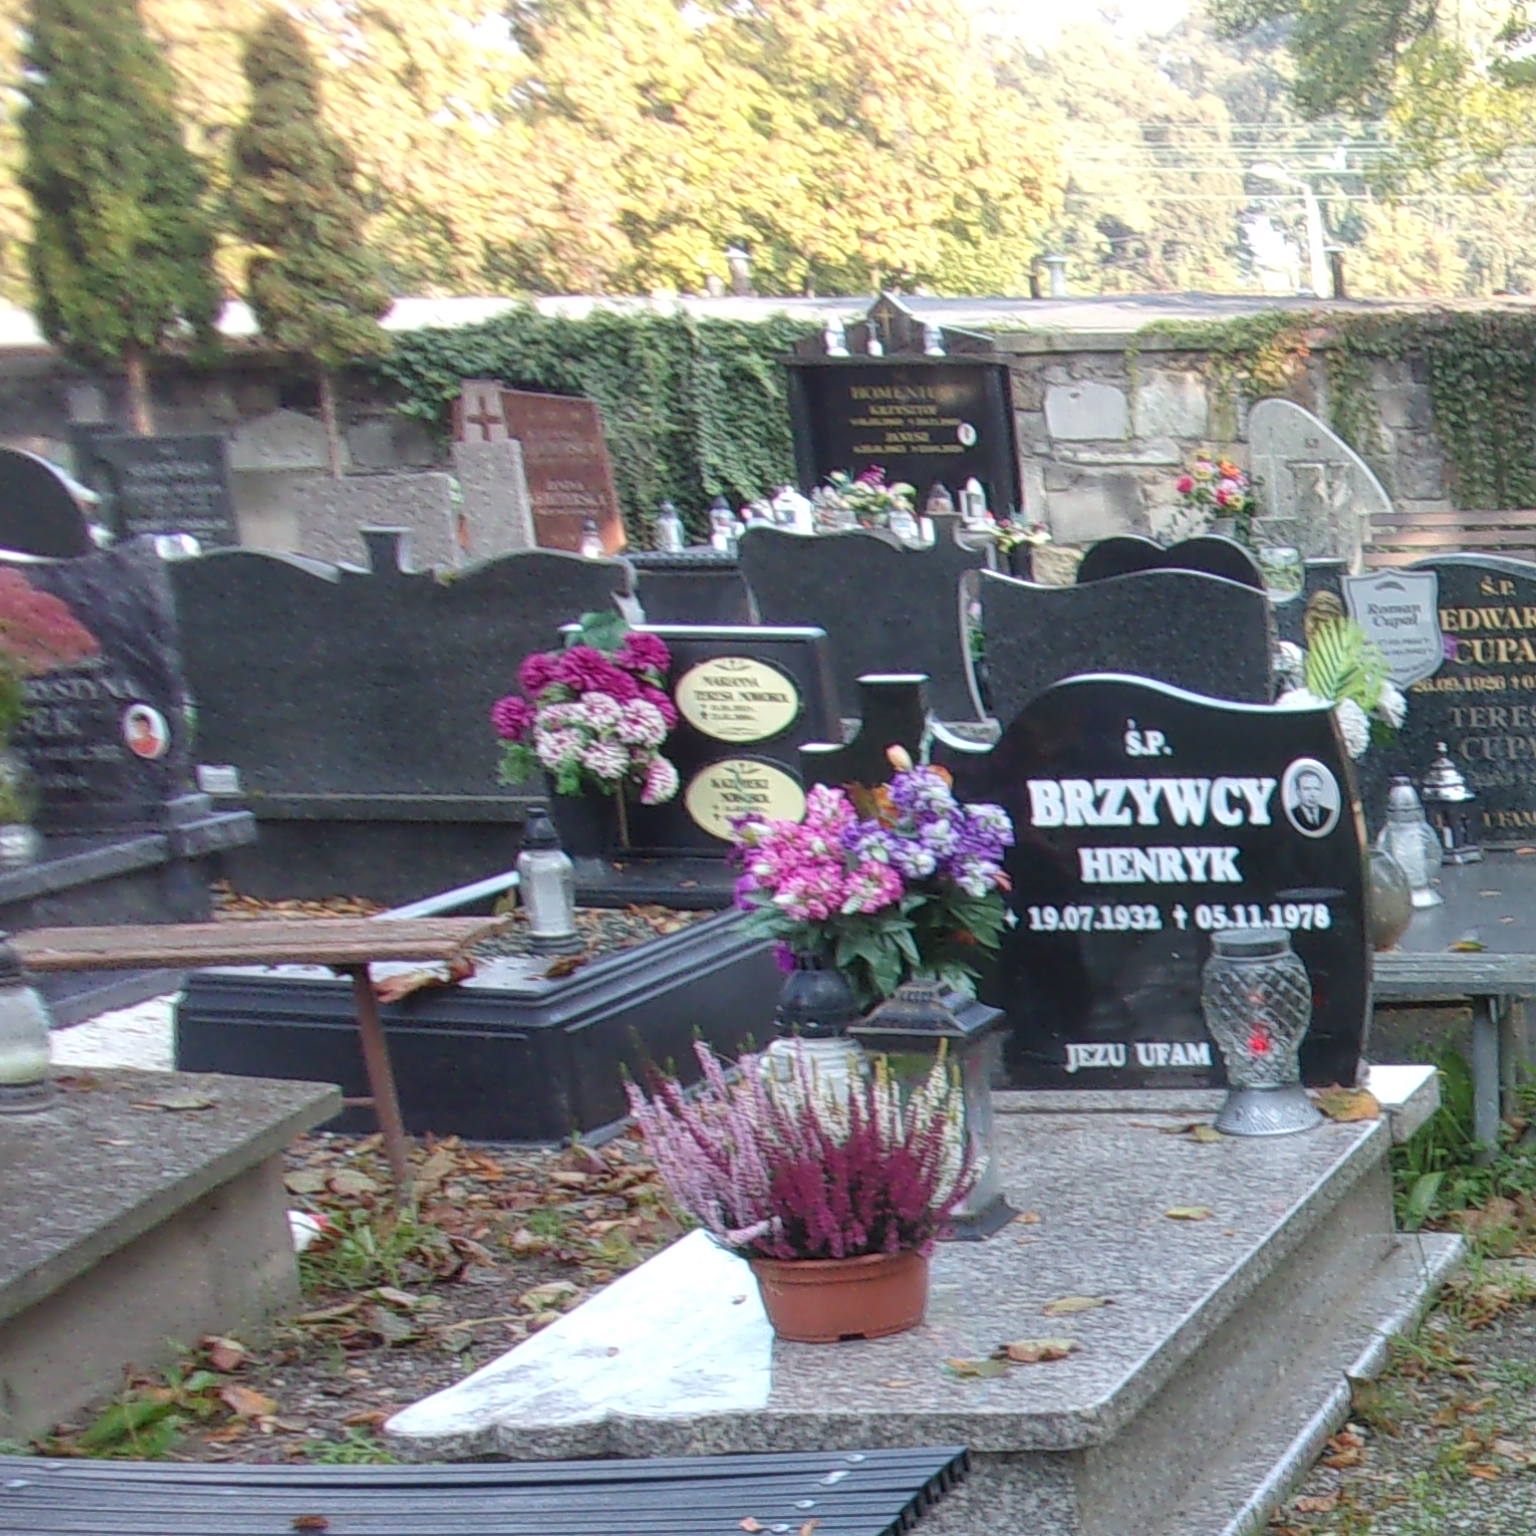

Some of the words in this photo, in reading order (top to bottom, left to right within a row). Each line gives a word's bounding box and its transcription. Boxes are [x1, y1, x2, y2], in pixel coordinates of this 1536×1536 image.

[1367, 603, 1421, 614] Roman
[1123, 718, 1173, 756] Ś.P.
[1026, 778, 1277, 828] BRZYWCY
[1077, 847, 1244, 883] HENRYK
[1028, 905, 1162, 931] 19.07.1932
[1194, 904, 1332, 930] 05.11.1978
[1064, 1042, 1126, 1074] JEZU
[1134, 1042, 1213, 1067] UFAM
